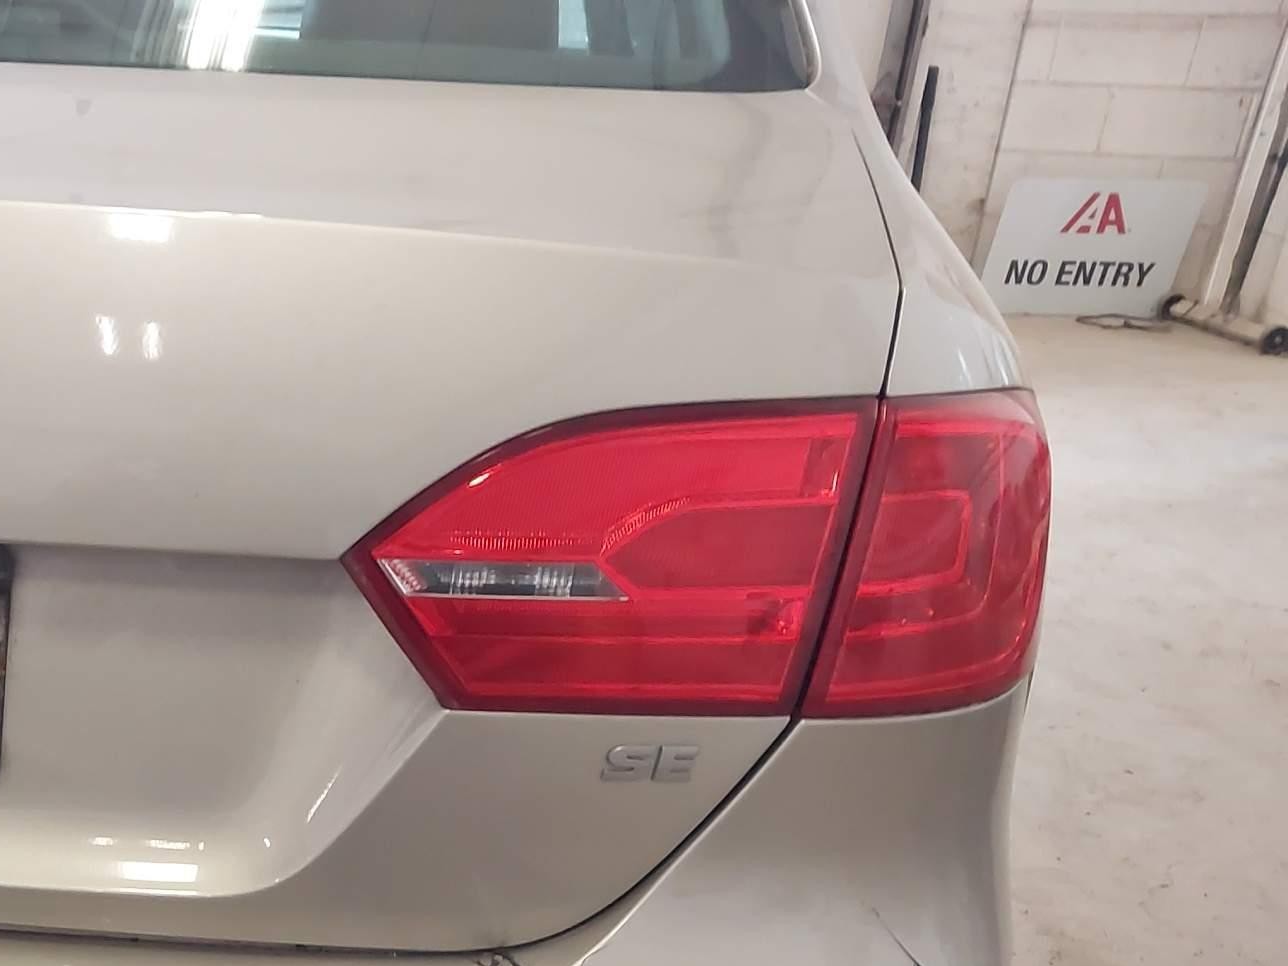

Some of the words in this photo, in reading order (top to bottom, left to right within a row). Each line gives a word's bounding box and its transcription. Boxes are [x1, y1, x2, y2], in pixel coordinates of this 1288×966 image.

[1004, 259, 1048, 285] NO
[1054, 260, 1156, 287] ENTRY
[600, 744, 699, 782] SE
